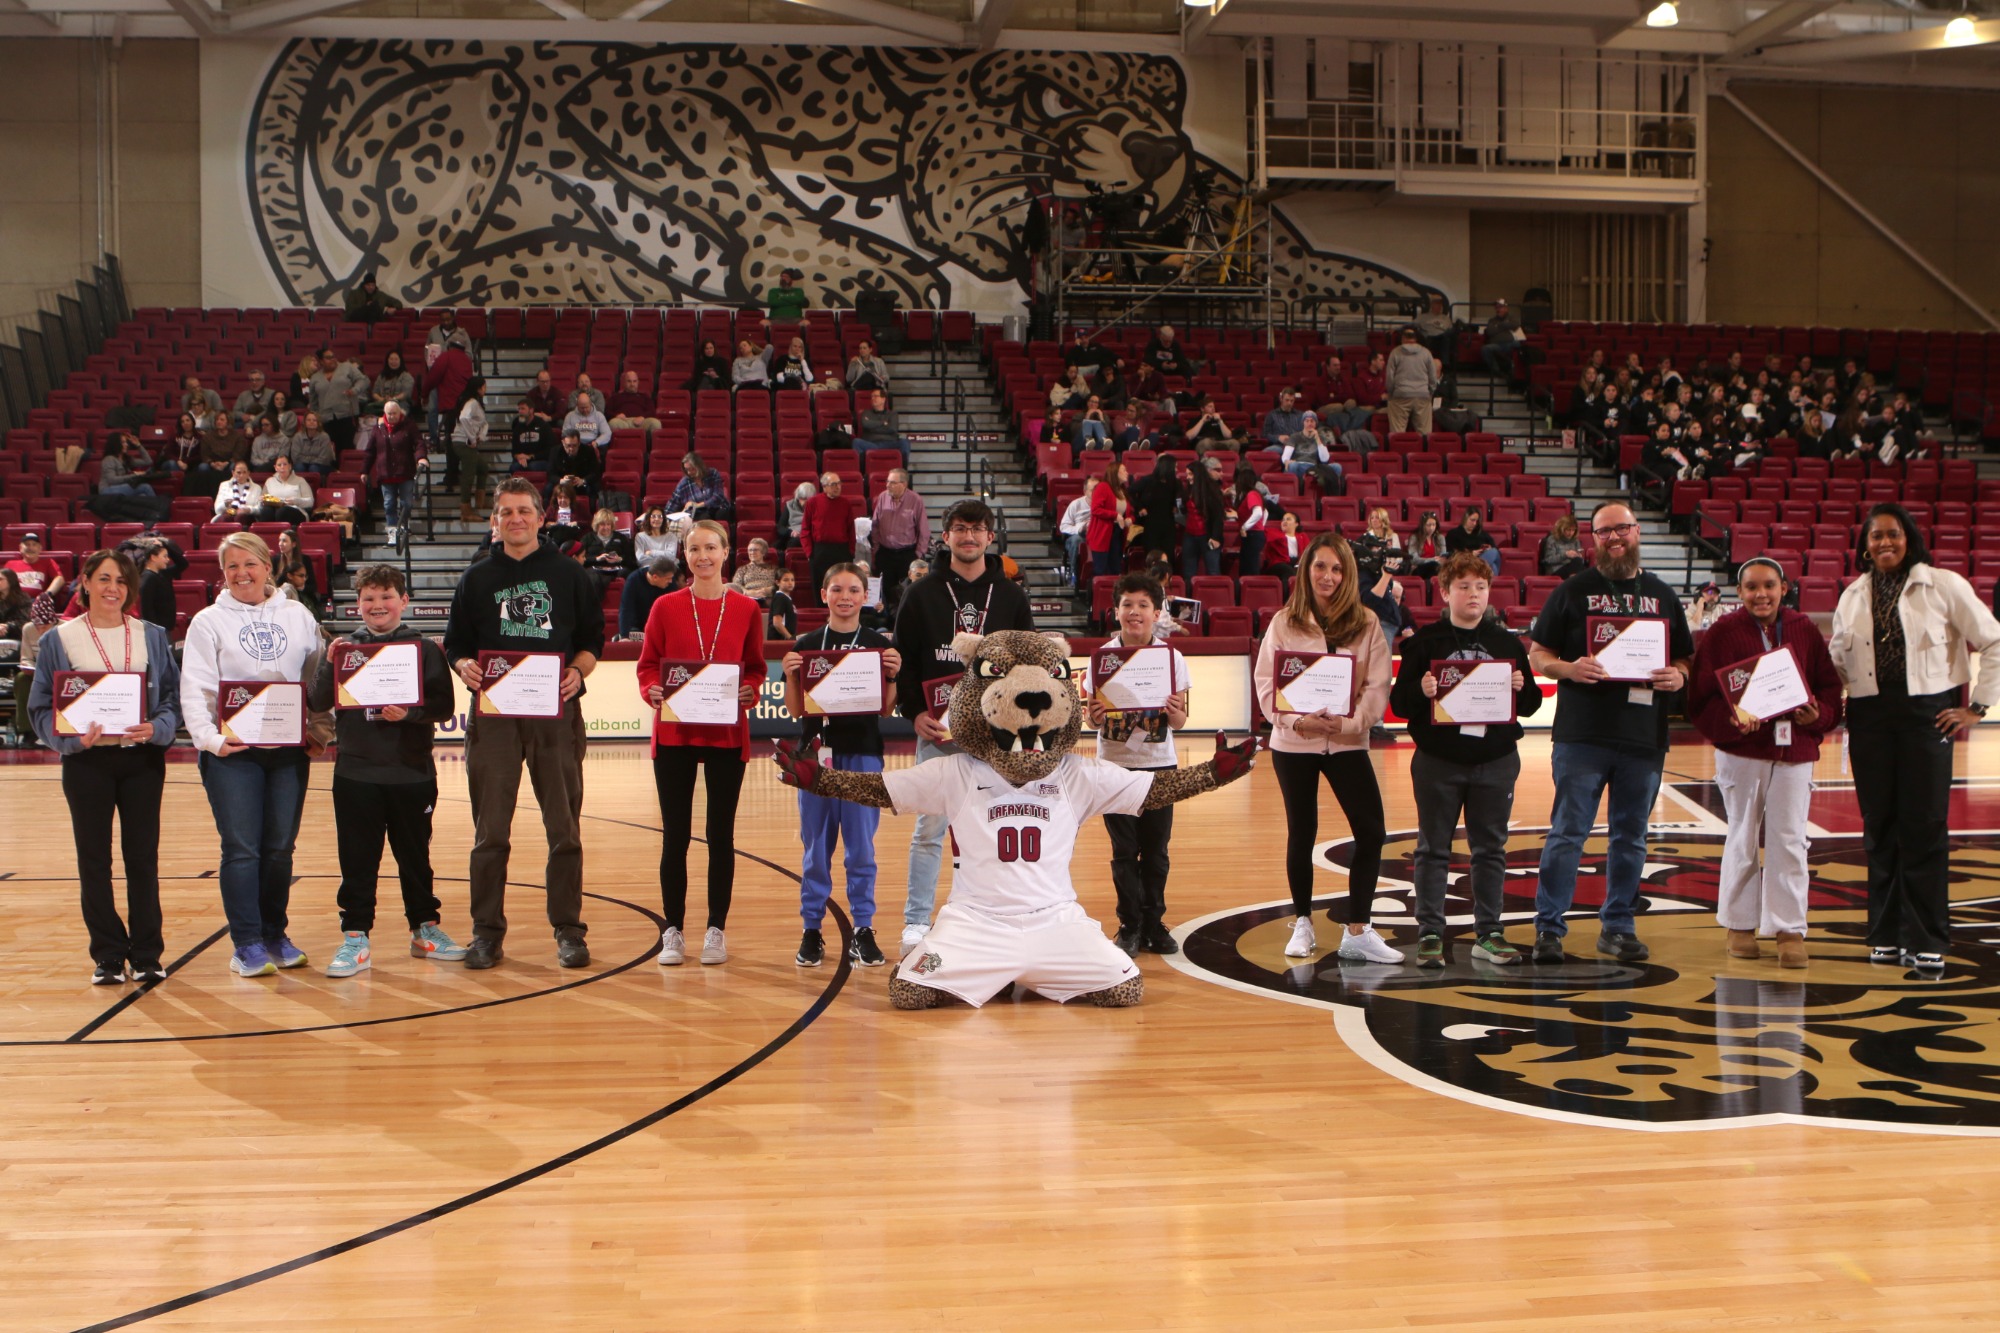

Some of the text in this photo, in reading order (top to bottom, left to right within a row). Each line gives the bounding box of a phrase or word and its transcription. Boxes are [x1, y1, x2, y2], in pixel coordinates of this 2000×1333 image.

[494, 580, 549, 605] PALMER
[415, 607, 442, 615] Section
[500, 618, 550, 640] PANTHERS
[988, 803, 1051, 823] LAFAYETTE
[997, 826, 1042, 863] 00
